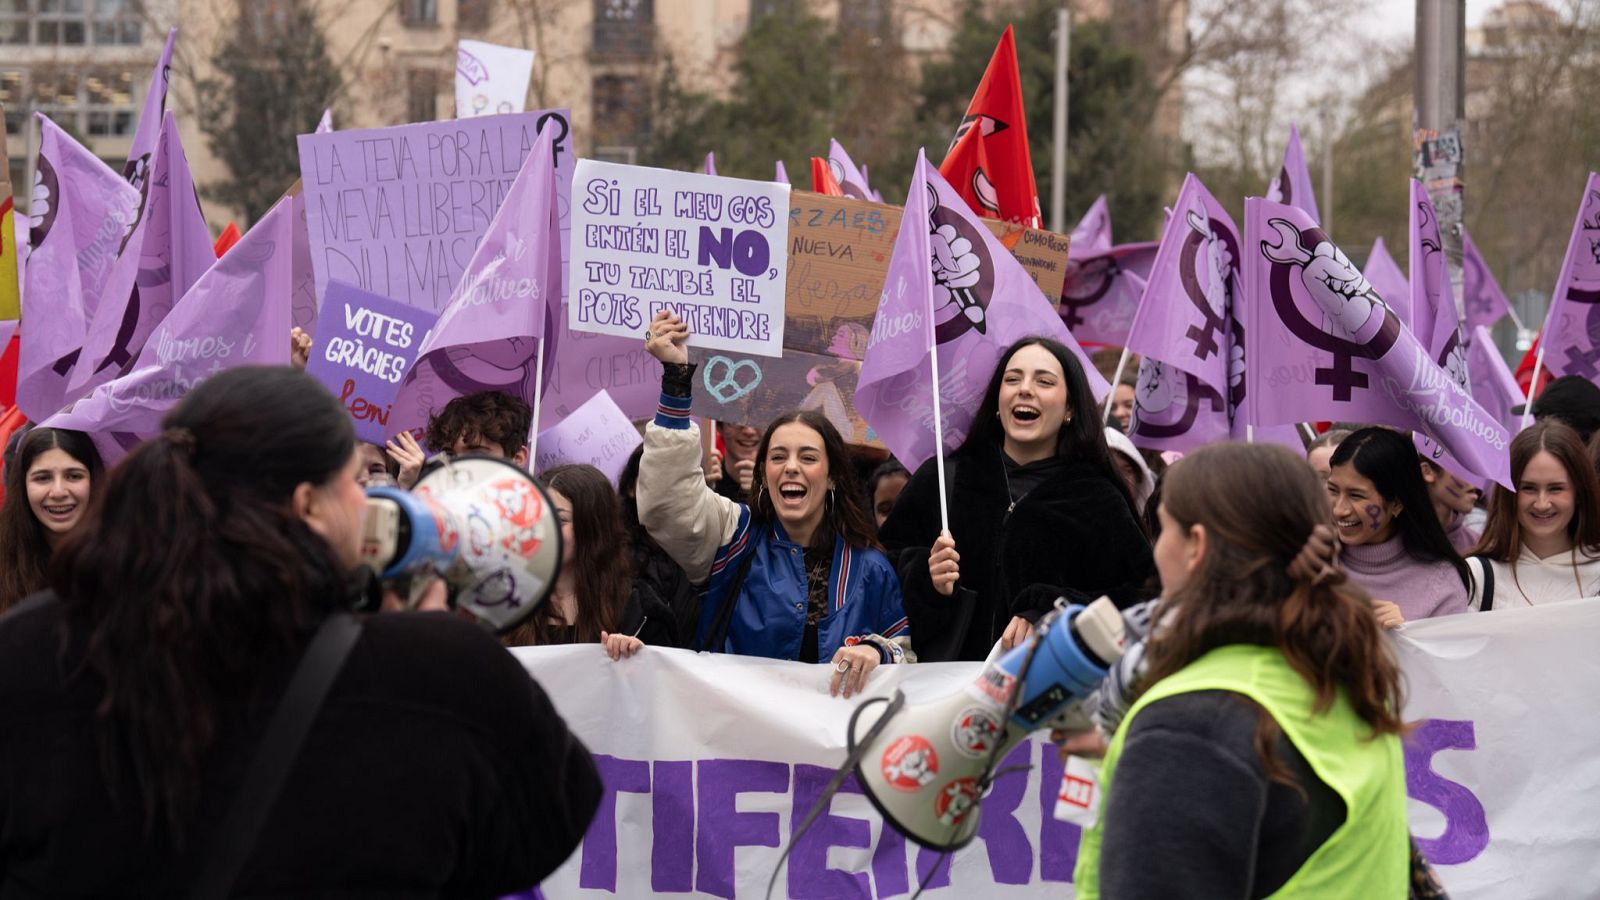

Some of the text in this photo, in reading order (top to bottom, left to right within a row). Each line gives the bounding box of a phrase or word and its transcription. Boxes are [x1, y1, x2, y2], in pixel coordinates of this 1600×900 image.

[313, 123, 532, 186] LA TEVA POR A LA
[319, 186, 397, 245] MEVA
[634, 188, 662, 217] EL
[674, 190, 723, 222] MEU
[727, 196, 775, 229] GOS
[585, 222, 779, 281] ENTÉN EL NO,
[792, 236, 854, 262] NUEVA
[404, 236, 484, 309] MAS
[585, 261, 761, 304] TU TAMBÉ EL
[344, 303, 414, 349] VOTES
[578, 288, 643, 330] POTS
[325, 337, 406, 384] GRÀCIES
